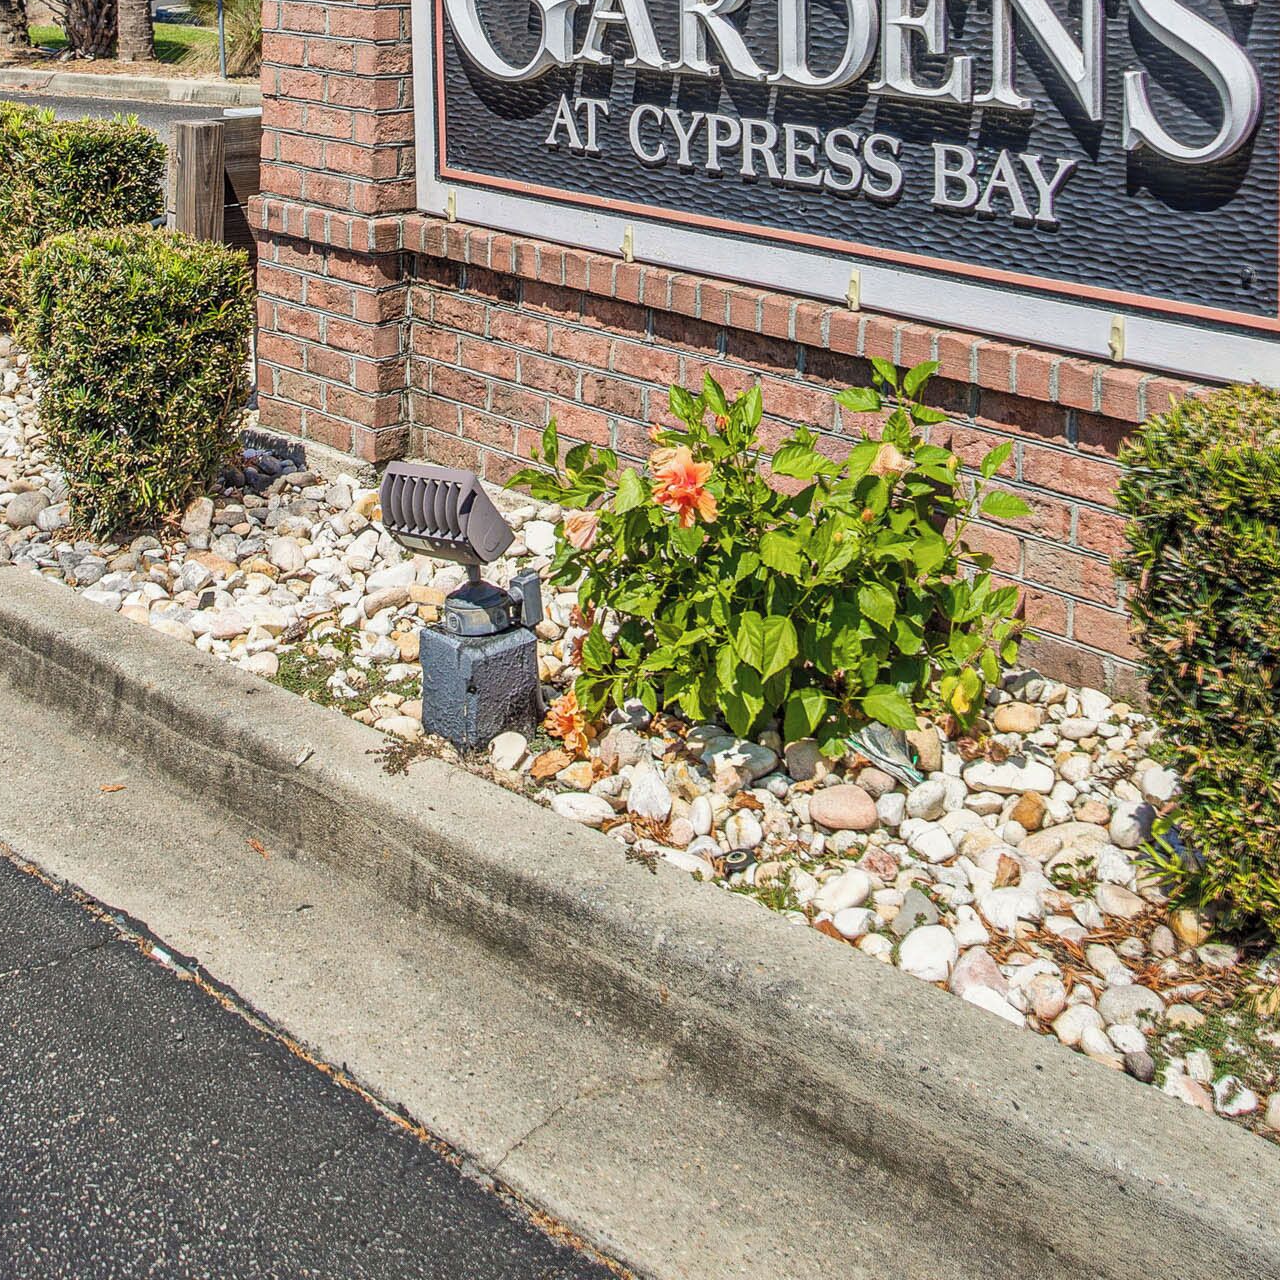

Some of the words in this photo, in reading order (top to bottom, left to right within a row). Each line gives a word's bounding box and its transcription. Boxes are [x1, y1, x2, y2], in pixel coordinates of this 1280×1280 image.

[545, 93, 609, 153] AT
[628, 103, 904, 199] CYPRESS
[931, 142, 1077, 222] BAY
